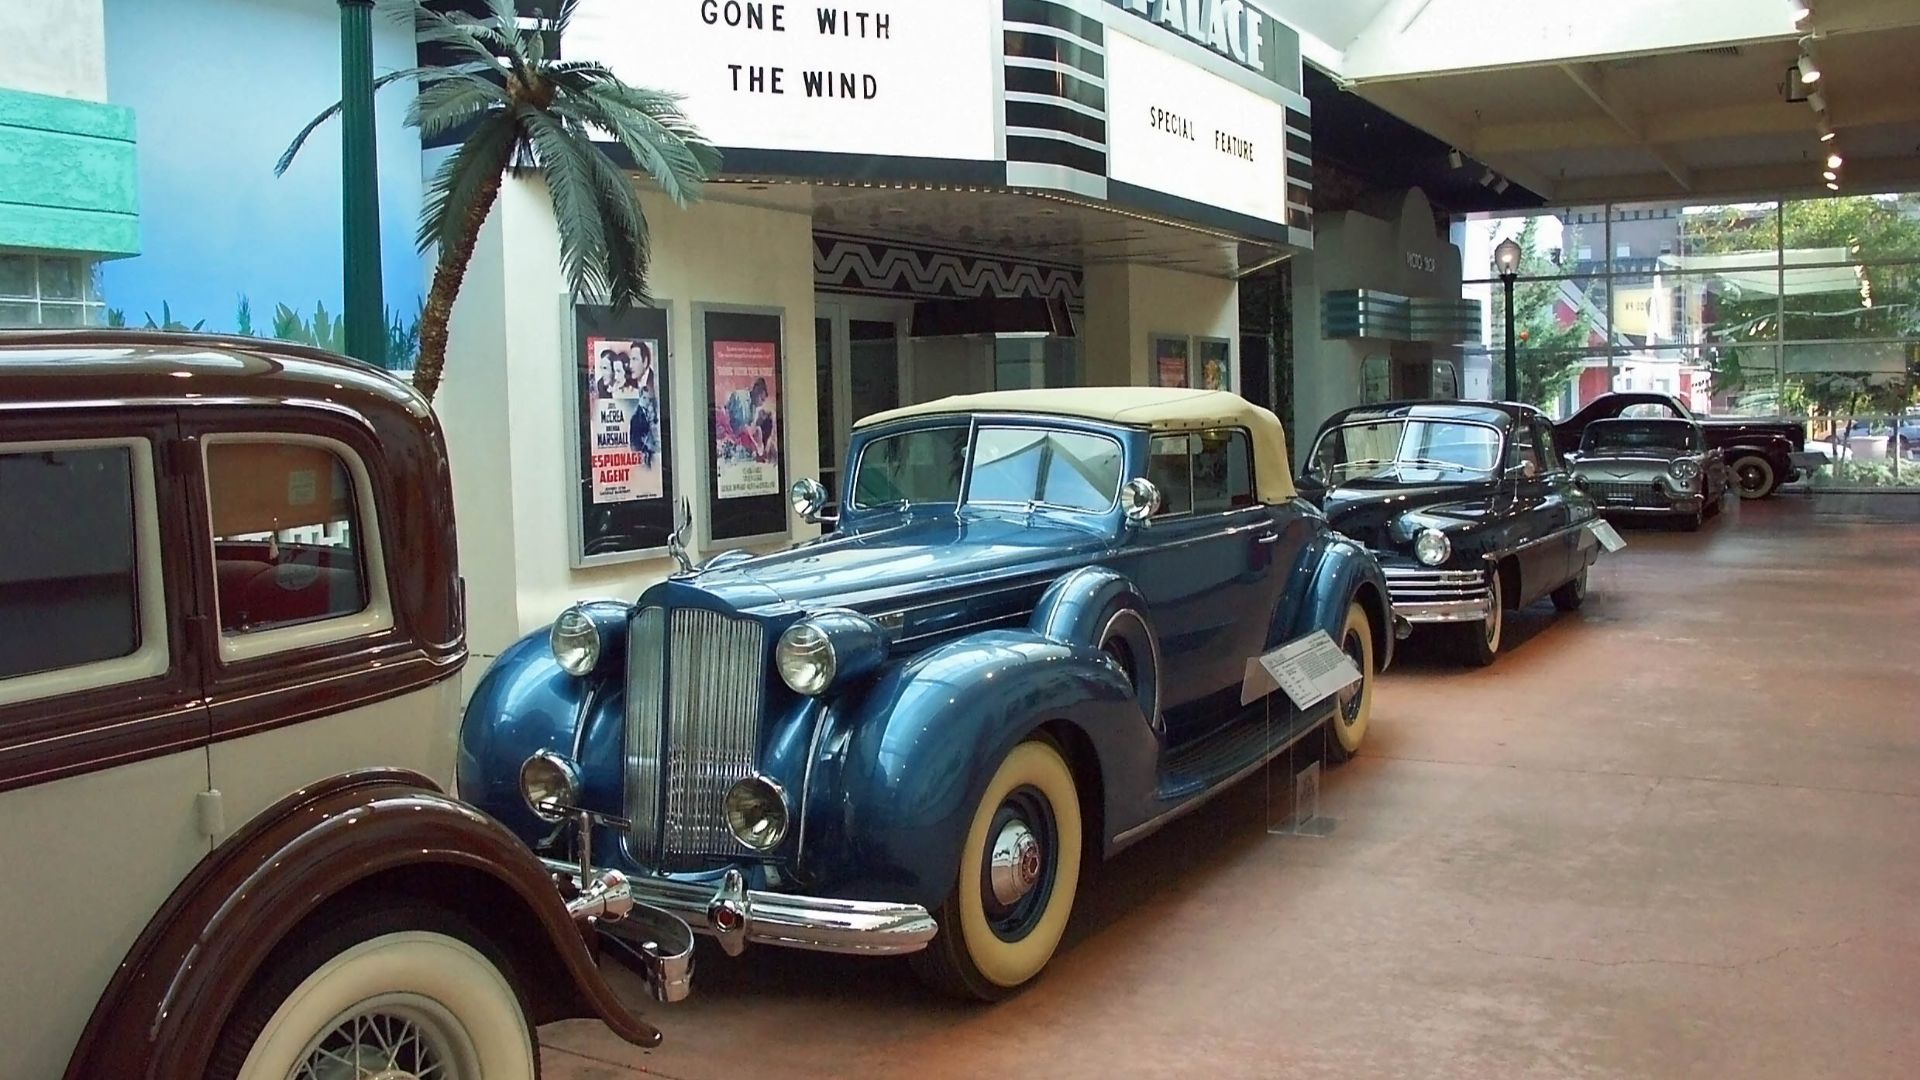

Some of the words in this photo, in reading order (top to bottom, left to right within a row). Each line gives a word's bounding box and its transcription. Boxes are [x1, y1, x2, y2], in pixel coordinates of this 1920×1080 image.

[701, 0, 785, 32] GONE
[817, 8, 890, 39] WITH
[1123, 0, 1265, 72] ALACE
[728, 64, 785, 94] THE
[803, 71, 878, 100] WIND
[1150, 106, 1195, 141] SPECIAL
[1215, 130, 1254, 162] FEATURE
[600, 410, 625, 423] McCREA
[597, 432, 629, 446] MARSHALL
[592, 452, 642, 468] ESPIONAGE
[600, 469, 630, 483] AGENT
